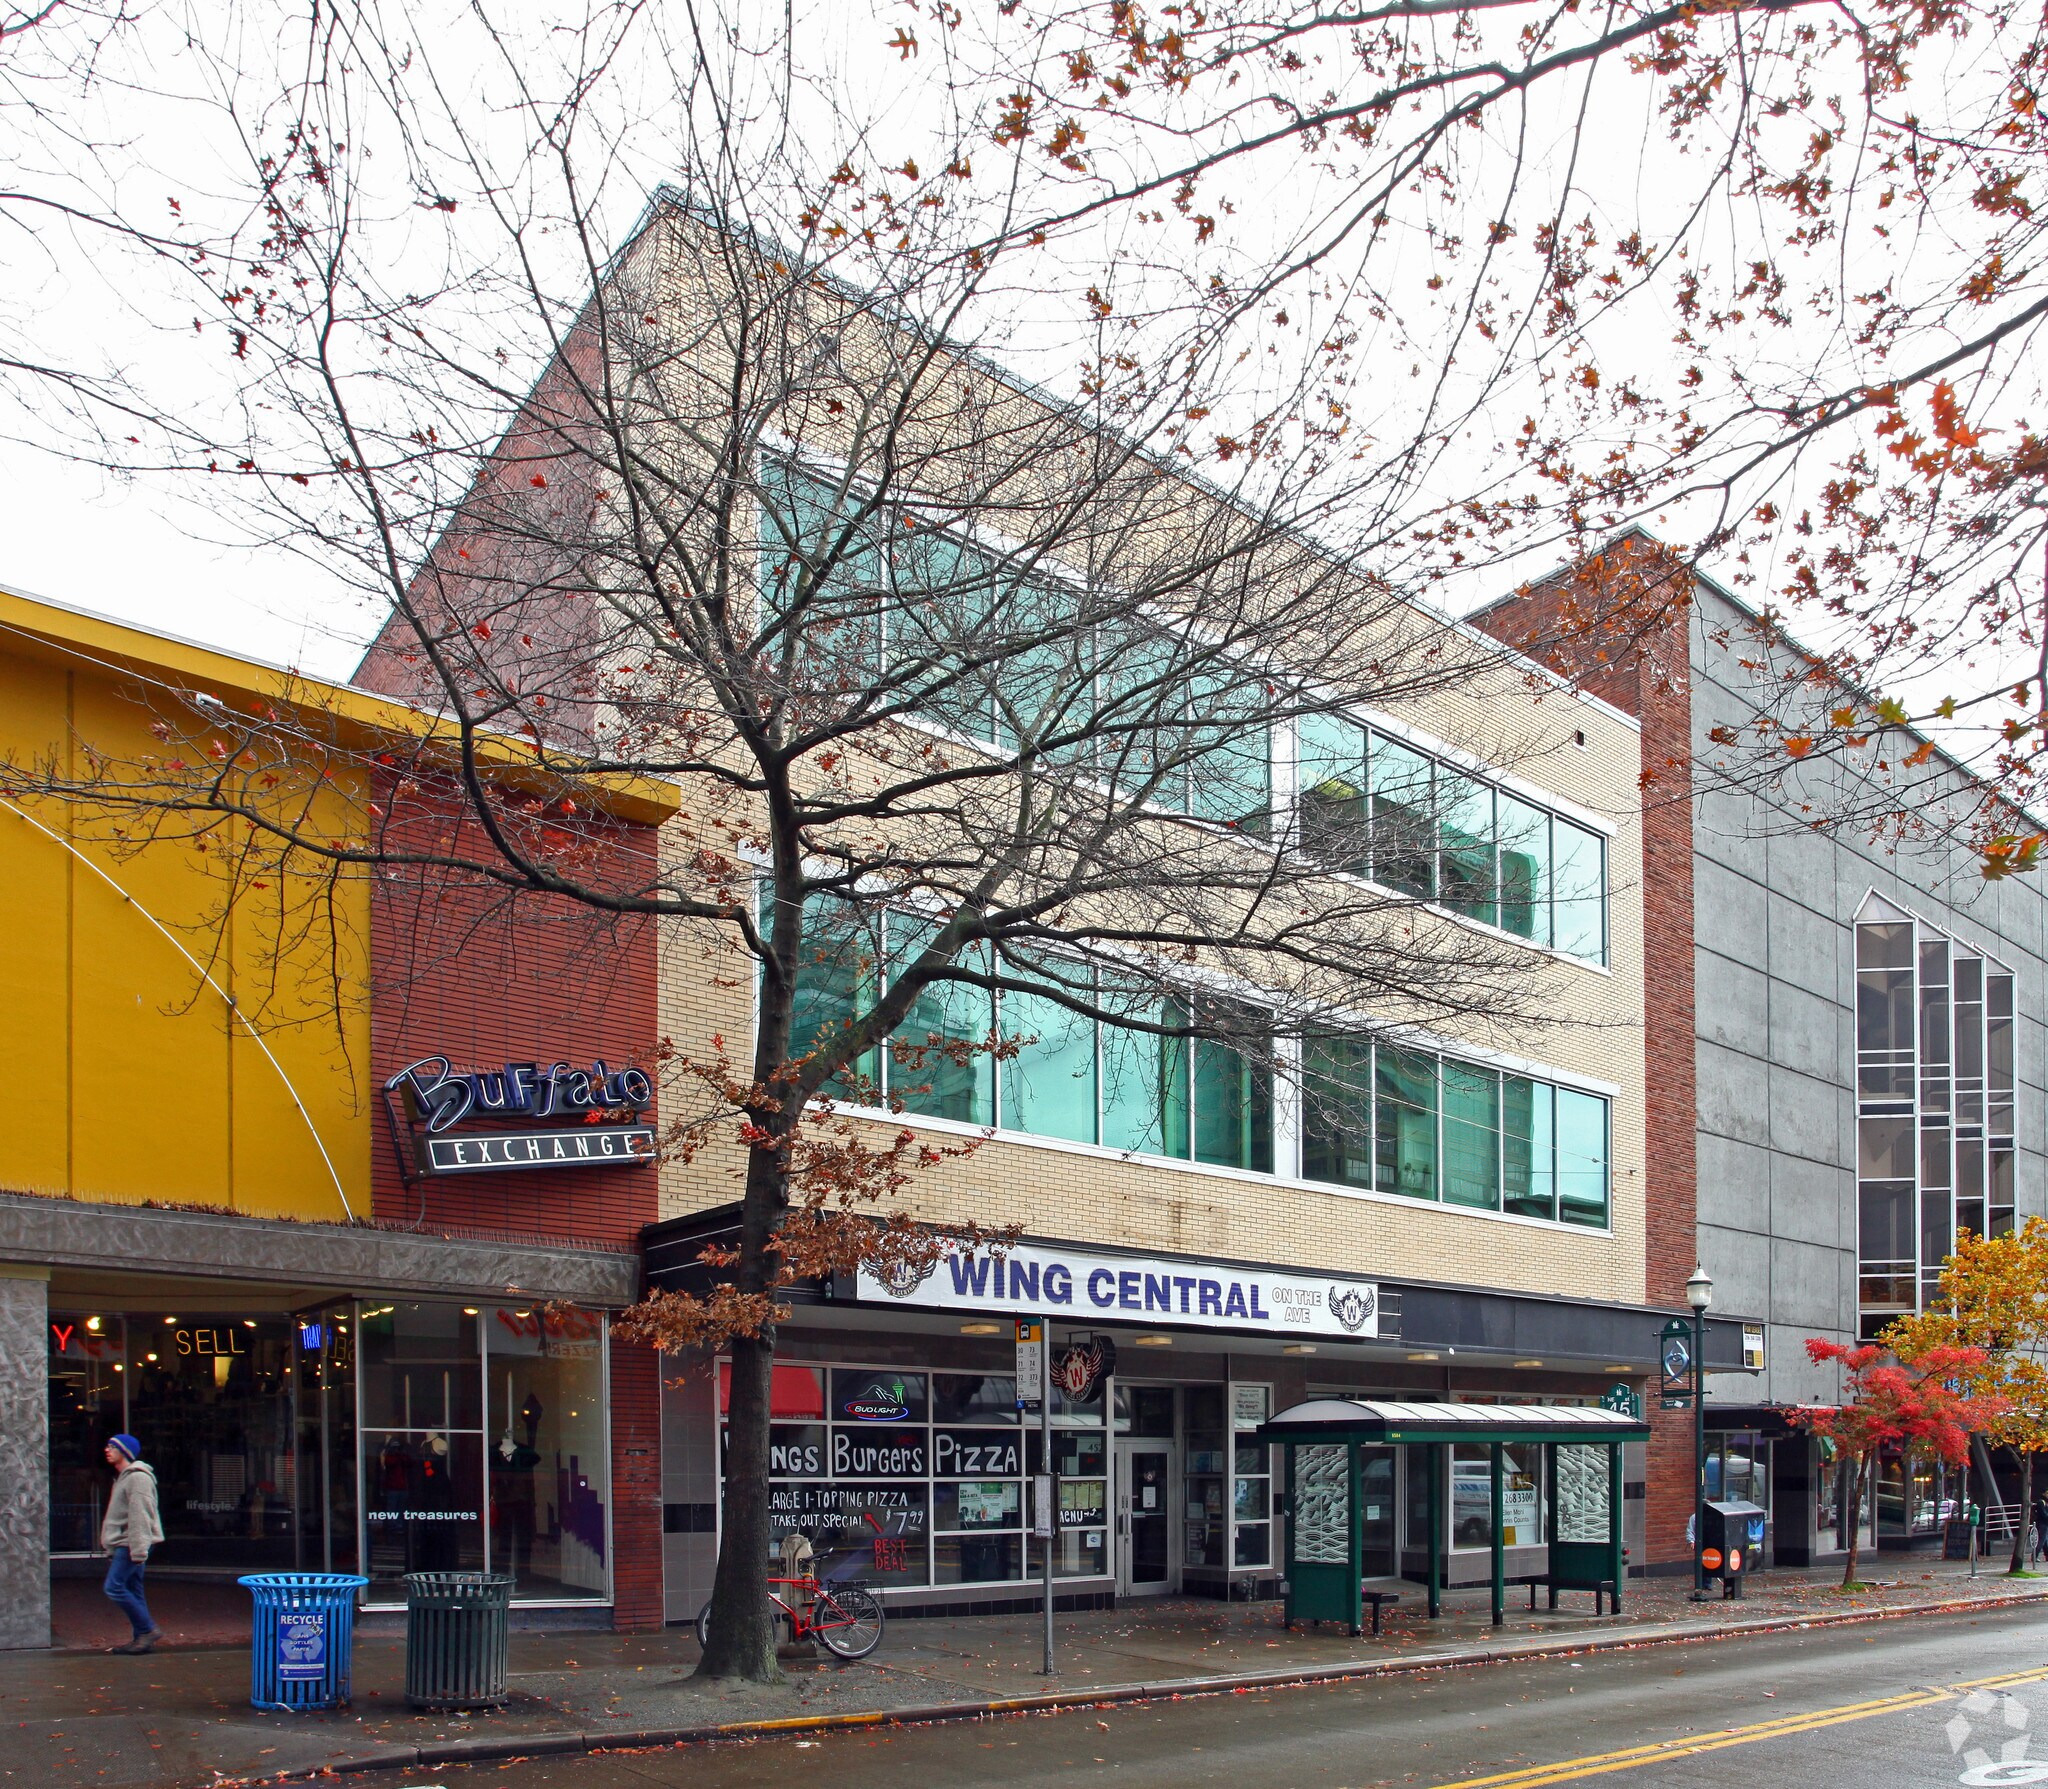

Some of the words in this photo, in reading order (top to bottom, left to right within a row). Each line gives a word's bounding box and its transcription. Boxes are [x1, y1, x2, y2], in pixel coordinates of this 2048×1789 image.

[454, 1133, 634, 1165] EXCHANGE
[949, 1252, 1073, 1305] WING
[1087, 1267, 1270, 1321] CENTRAL
[1271, 1286, 1292, 1304] ON
[1294, 1289, 1322, 1307] THE
[1284, 1306, 1311, 1324] AVE
[1346, 1305, 1357, 1321] W
[175, 1328, 246, 1355] SELL
[1069, 1365, 1083, 1388] W
[854, 1405, 874, 1413] BUD
[874, 1406, 898, 1414] LIGHT
[1609, 1401, 1631, 1416] 45
[768, 1491, 800, 1510] ARGE
[867, 1491, 908, 1508] PIZZA
[1505, 1493, 1516, 1503] 268
[1518, 1492, 1533, 1503] 3300
[368, 1511, 399, 1520] new
[403, 1508, 478, 1521] treasures
[771, 1514, 798, 1527] TAKE
[801, 1514, 820, 1527] OUT
[874, 1538, 907, 1555] BEST
[874, 1555, 908, 1572] DEAL
[280, 1614, 324, 1625] RECYCLE
